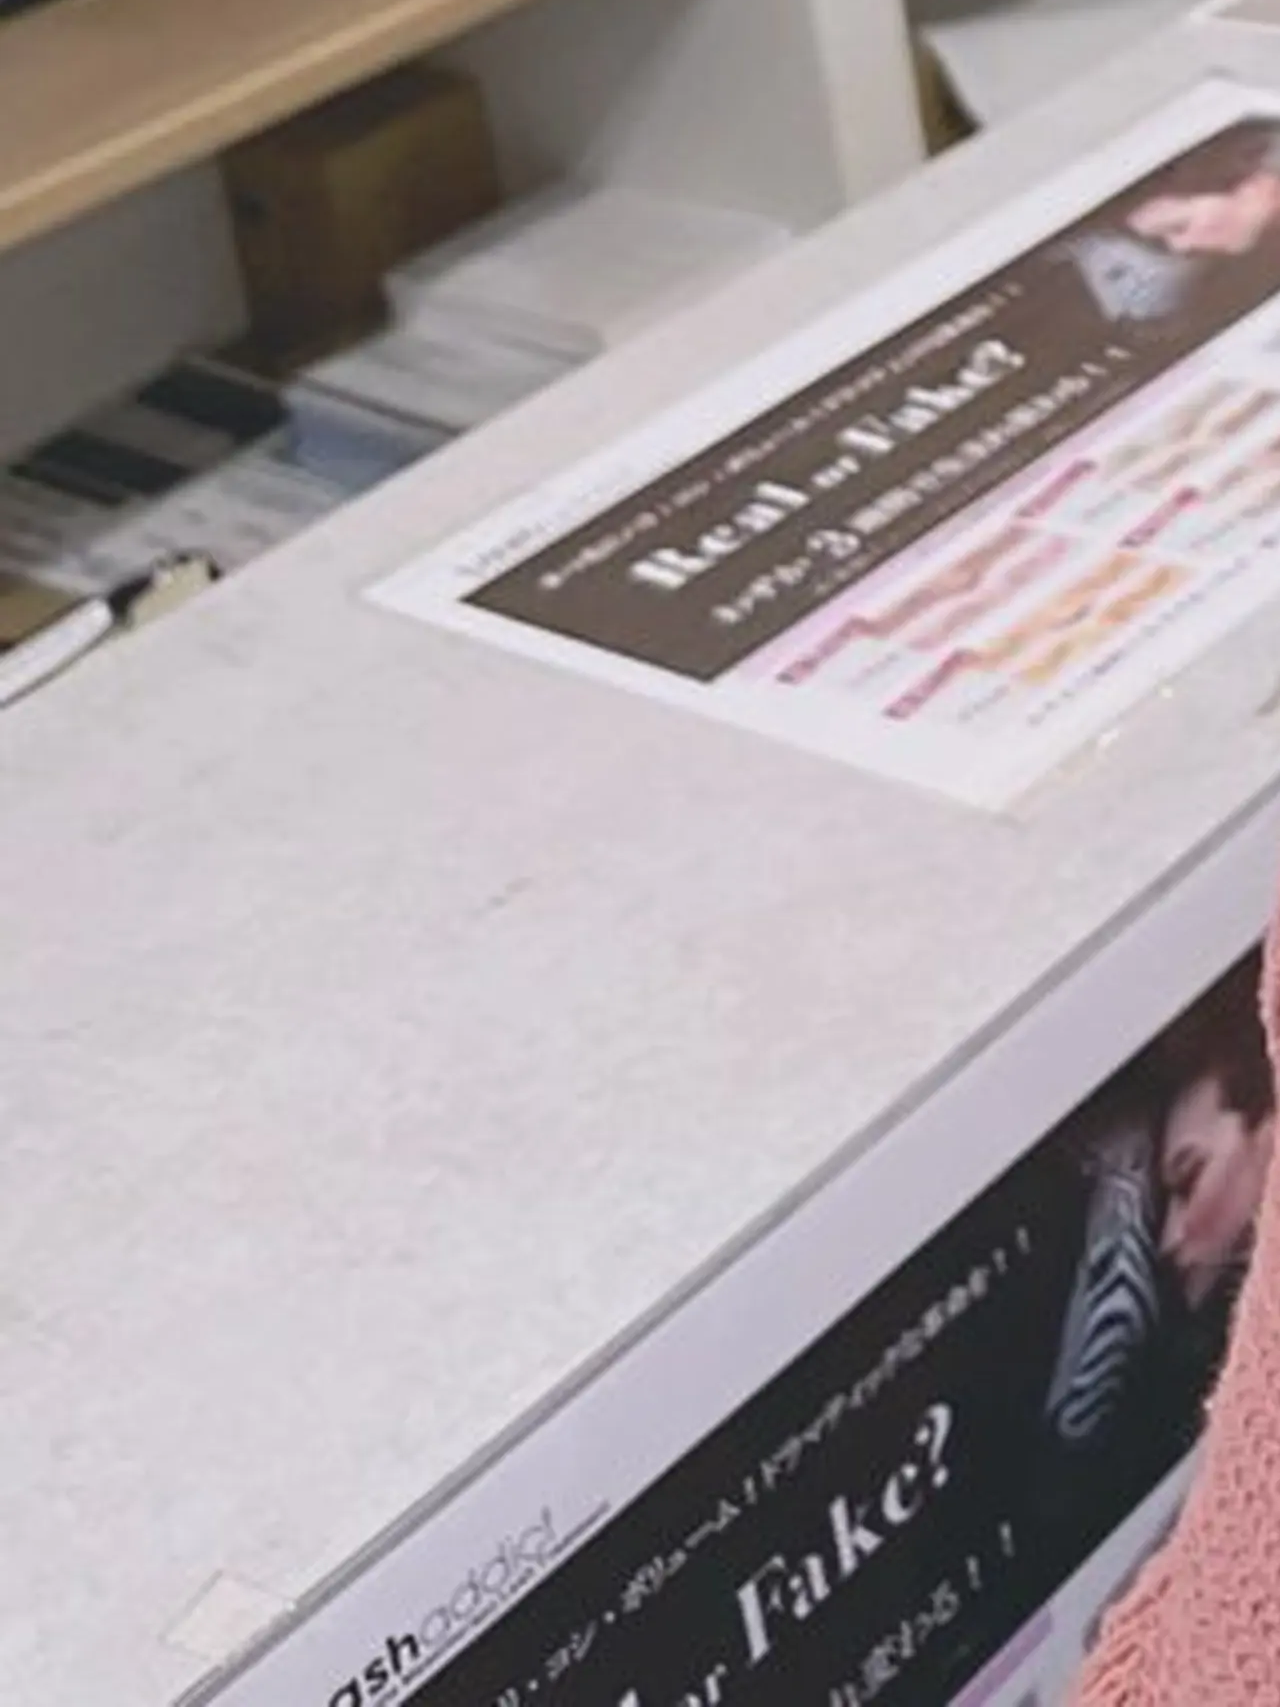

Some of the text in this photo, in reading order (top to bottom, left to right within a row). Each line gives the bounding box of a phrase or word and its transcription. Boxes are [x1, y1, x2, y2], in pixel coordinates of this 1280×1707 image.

[630, 479, 809, 589] Real
[837, 340, 1025, 455] Fake?
[737, 1403, 951, 1666] Fake?
